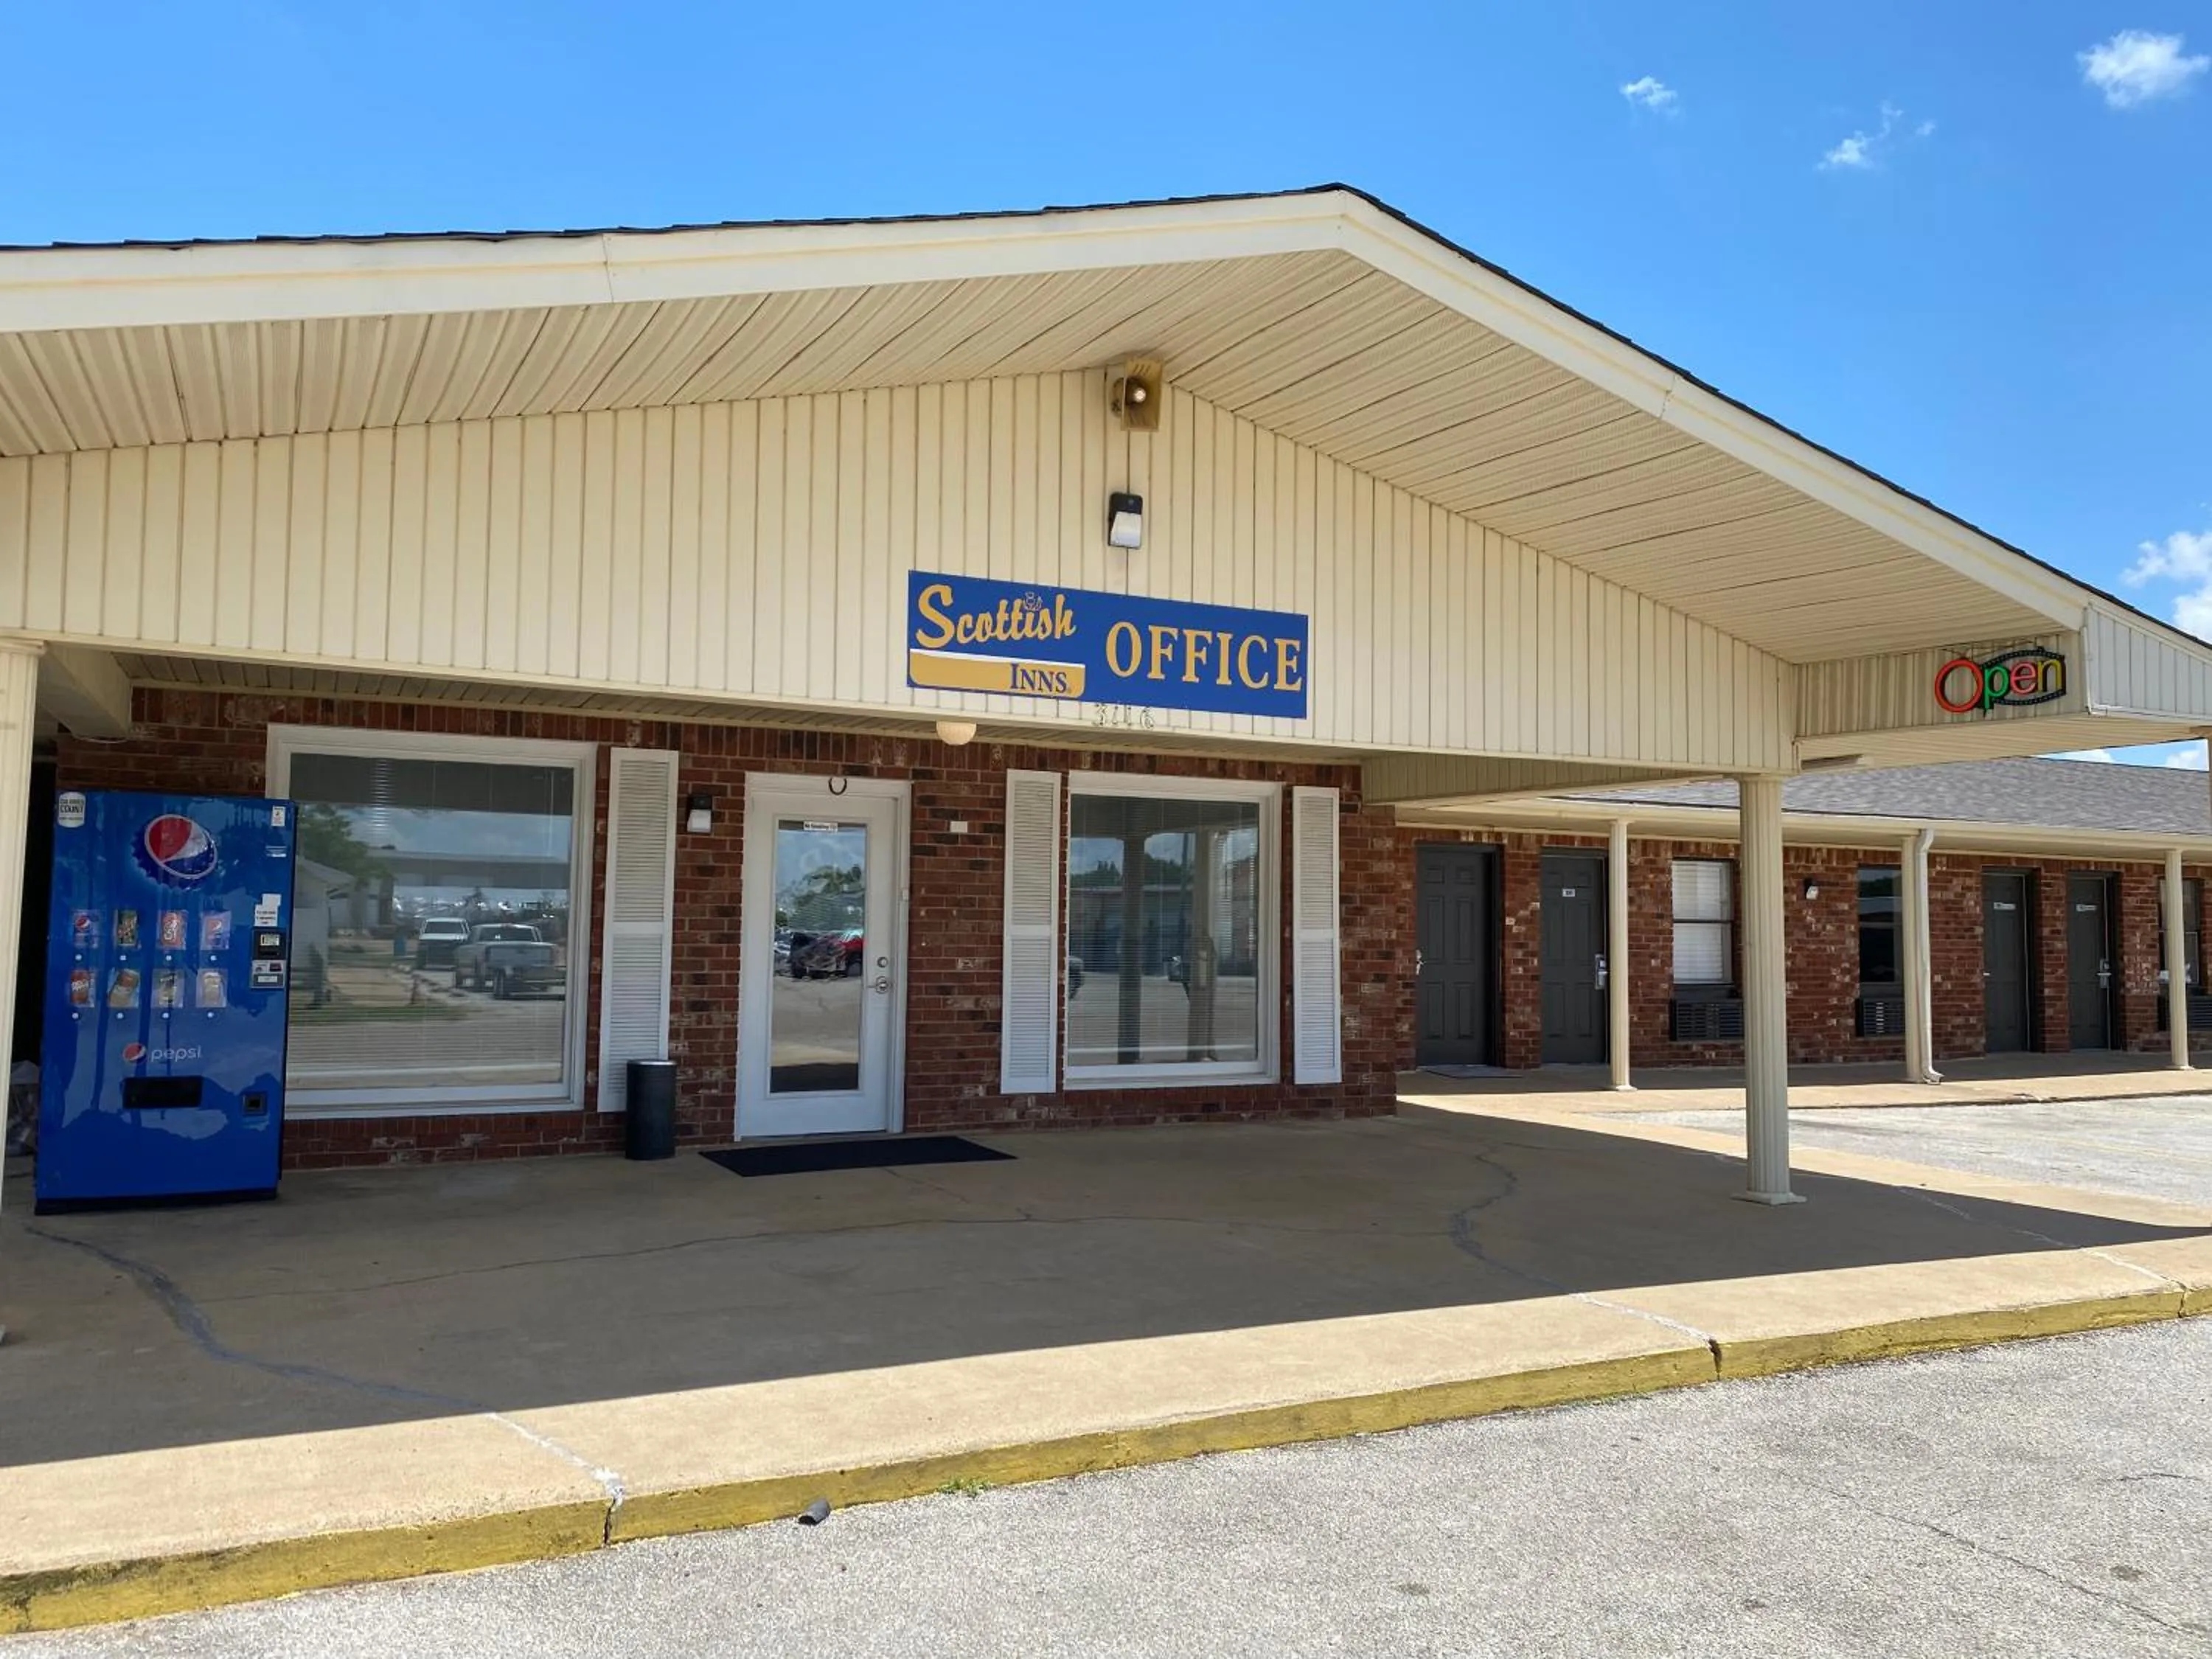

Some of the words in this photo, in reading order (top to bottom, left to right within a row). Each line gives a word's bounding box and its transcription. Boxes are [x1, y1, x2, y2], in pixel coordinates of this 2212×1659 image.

[916, 584, 1077, 649] Scottish
[1010, 663, 1067, 694] INNS
[1106, 621, 1302, 692] OFFICE
[1934, 658, 2063, 713] Open
[150, 1045, 201, 1062] pepsi
